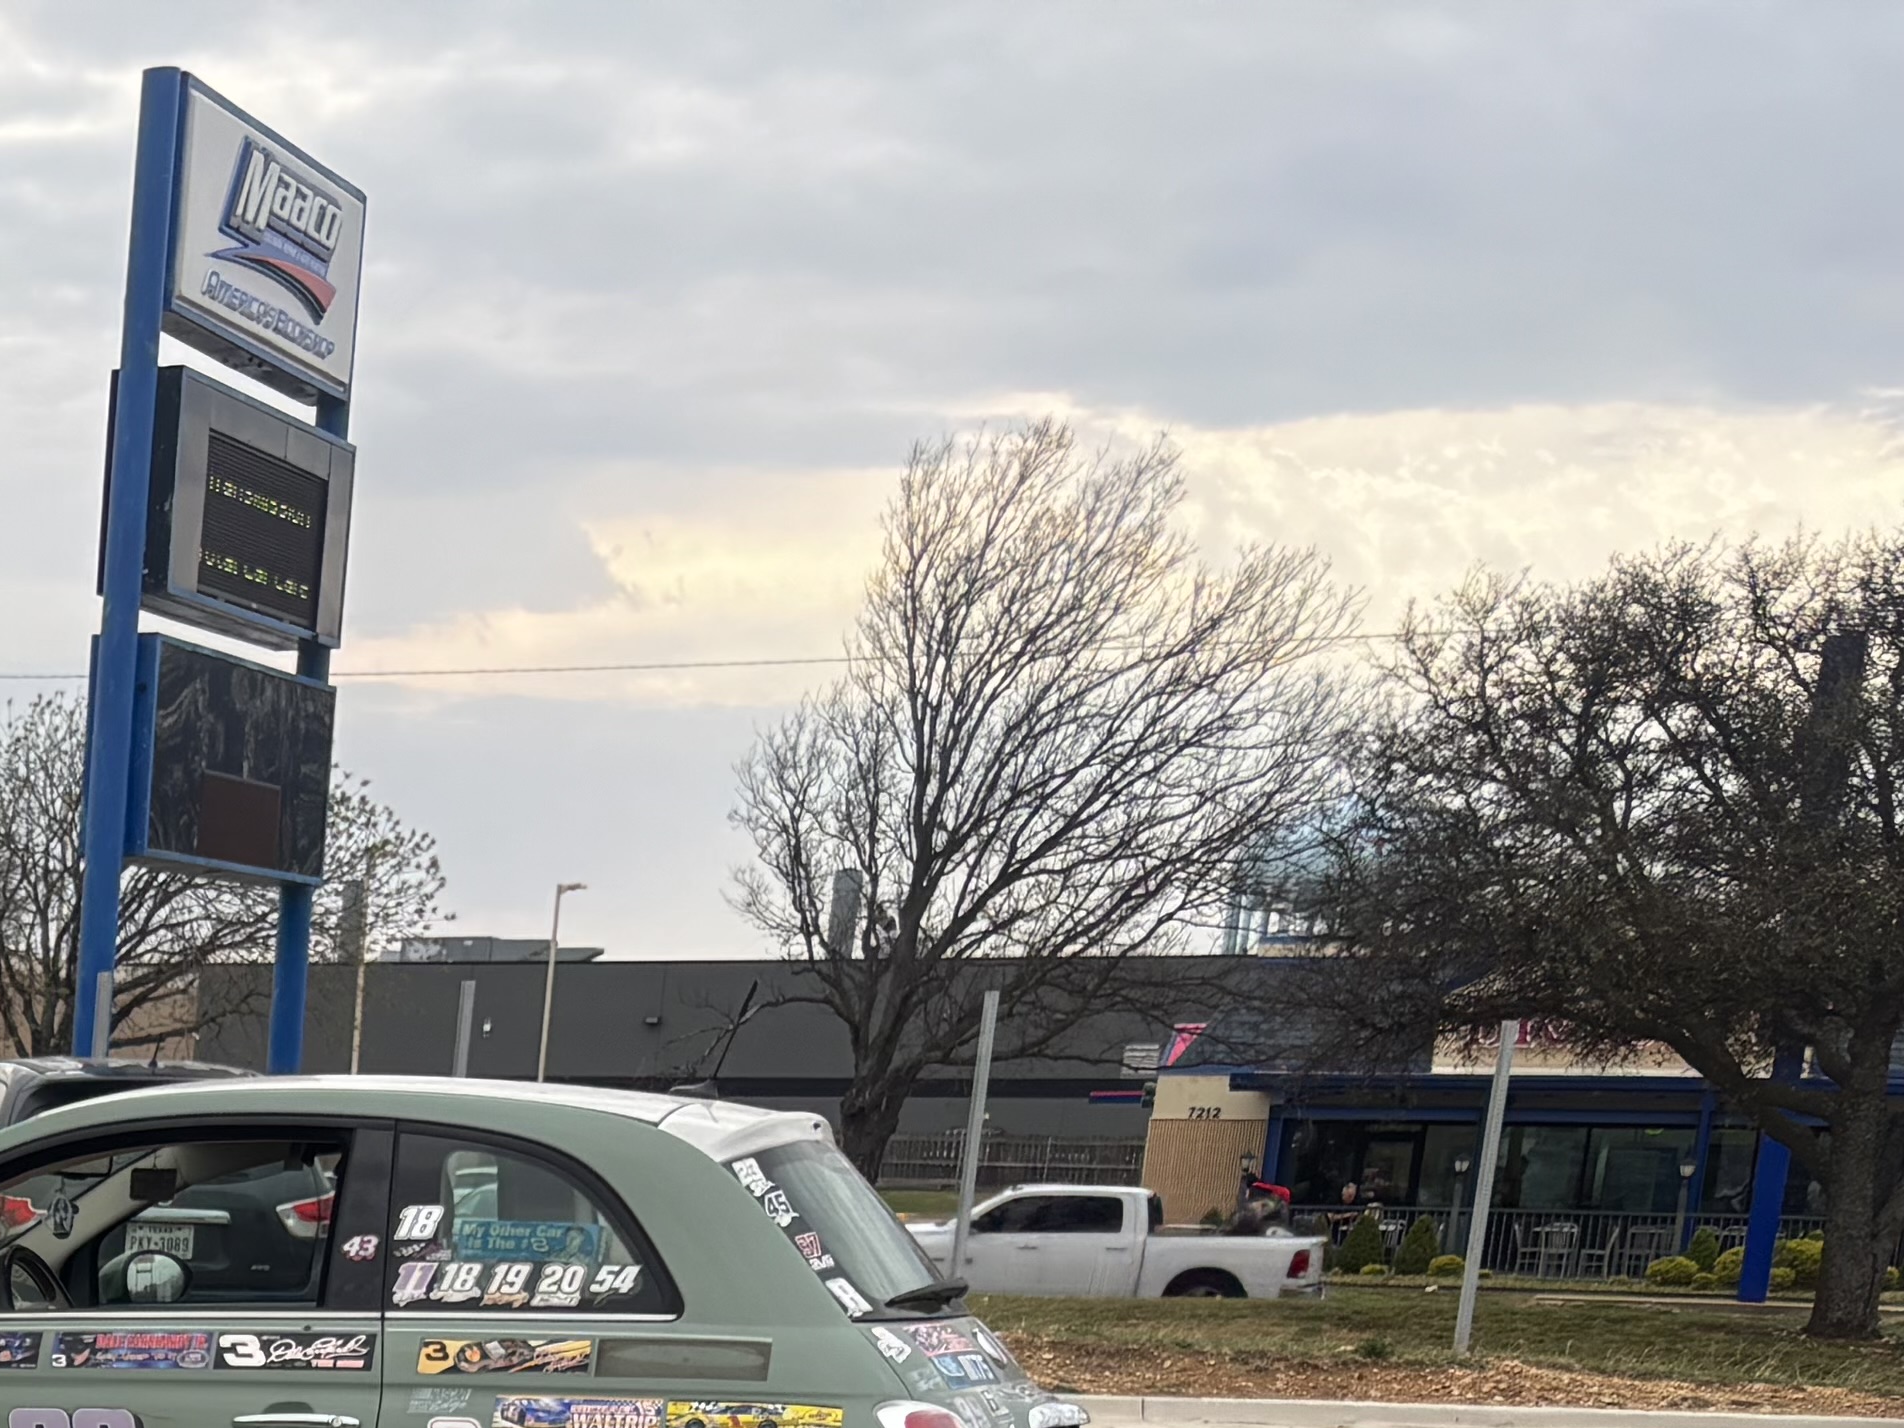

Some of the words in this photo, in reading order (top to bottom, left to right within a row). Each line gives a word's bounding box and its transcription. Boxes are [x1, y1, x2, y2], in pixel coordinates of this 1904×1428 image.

[235, 149, 342, 250] Maaco
[1187, 1106, 1221, 1120] 7212
[394, 1205, 444, 1240] 18
[343, 1235, 379, 1258] 43
[392, 1262, 439, 1292] 11
[441, 1262, 483, 1292] 18
[489, 1263, 534, 1295] 19
[538, 1264, 585, 1294] 20
[589, 1264, 642, 1294] 54
[51, 1354, 67, 1367] 3
[219, 1334, 267, 1367] 3
[423, 1341, 450, 1362] 3
